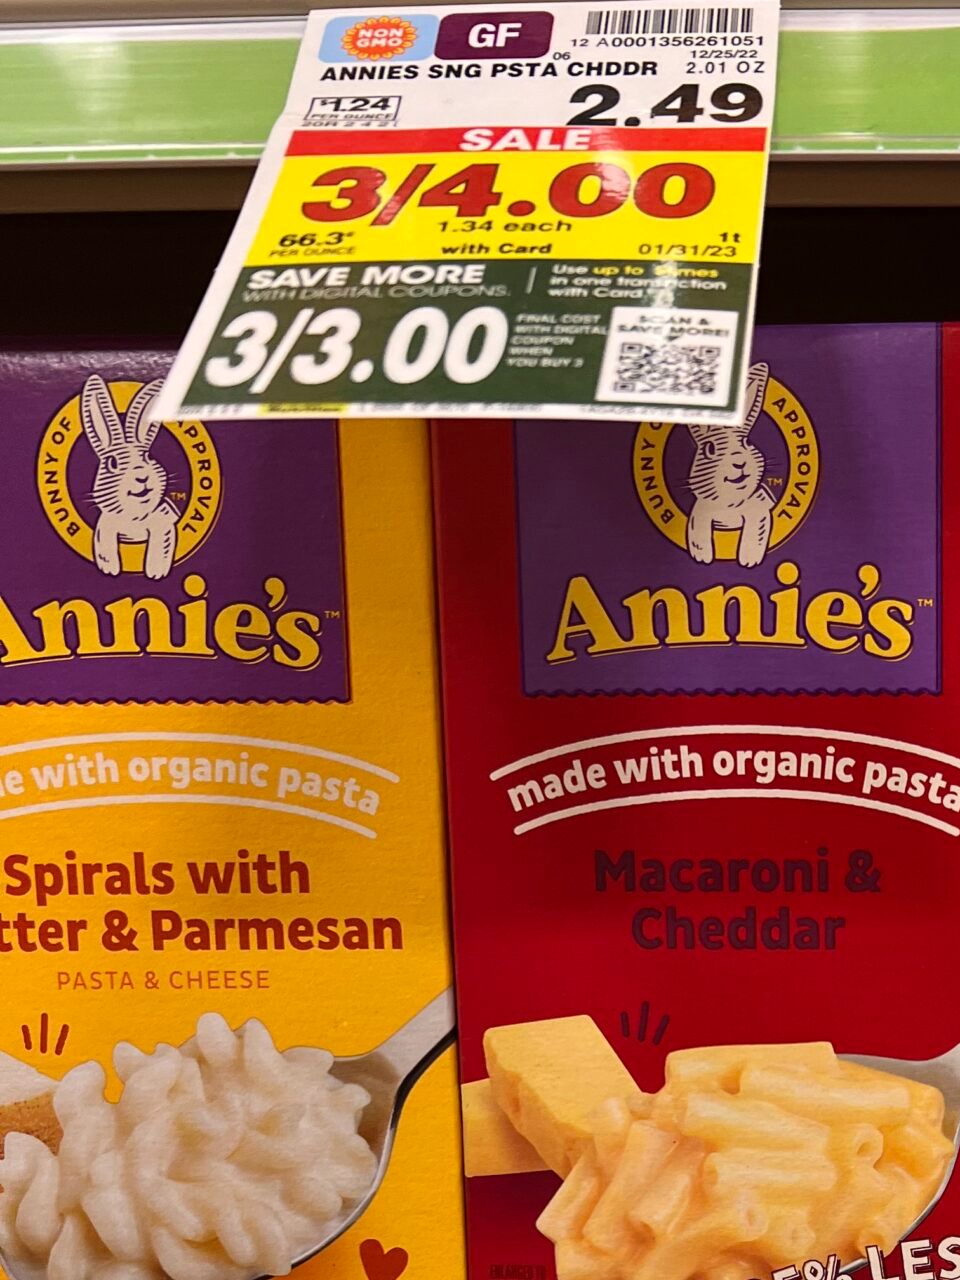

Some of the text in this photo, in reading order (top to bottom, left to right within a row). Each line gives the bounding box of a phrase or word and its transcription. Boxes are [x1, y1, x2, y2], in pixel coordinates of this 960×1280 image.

[356, 38, 403, 48] GMO
[358, 28, 403, 38] NON
[468, 22, 522, 48] GF
[571, 36, 764, 48] 12 A0001356261051
[552, 50, 758, 61] 06 12/25/22
[320, 61, 658, 81] ANNIES SNG PSTA CHDDR
[686, 61, 765, 74] 2.01 OZ
[566, 82, 763, 127] 2.49
[459, 127, 593, 151] SALE
[301, 162, 716, 227] 3/4.00
[438, 220, 572, 232] 1.34 each
[441, 243, 552, 255] with Card
[638, 243, 737, 257] 01/31/23
[246, 264, 486, 291] SAVE MORE
[242, 288, 300, 303] WITH
[301, 285, 382, 301] DIGITAL
[204, 305, 509, 395] 3/3.00
[545, 561, 916, 662] Annie's
[507, 756, 608, 813] made
[613, 745, 704, 785] with
[712, 746, 854, 785] organic
[4, 850, 310, 906] Spirals with
[102, 910, 403, 953] & Parmesan
[57, 970, 271, 991] PASTA & CHEESE
